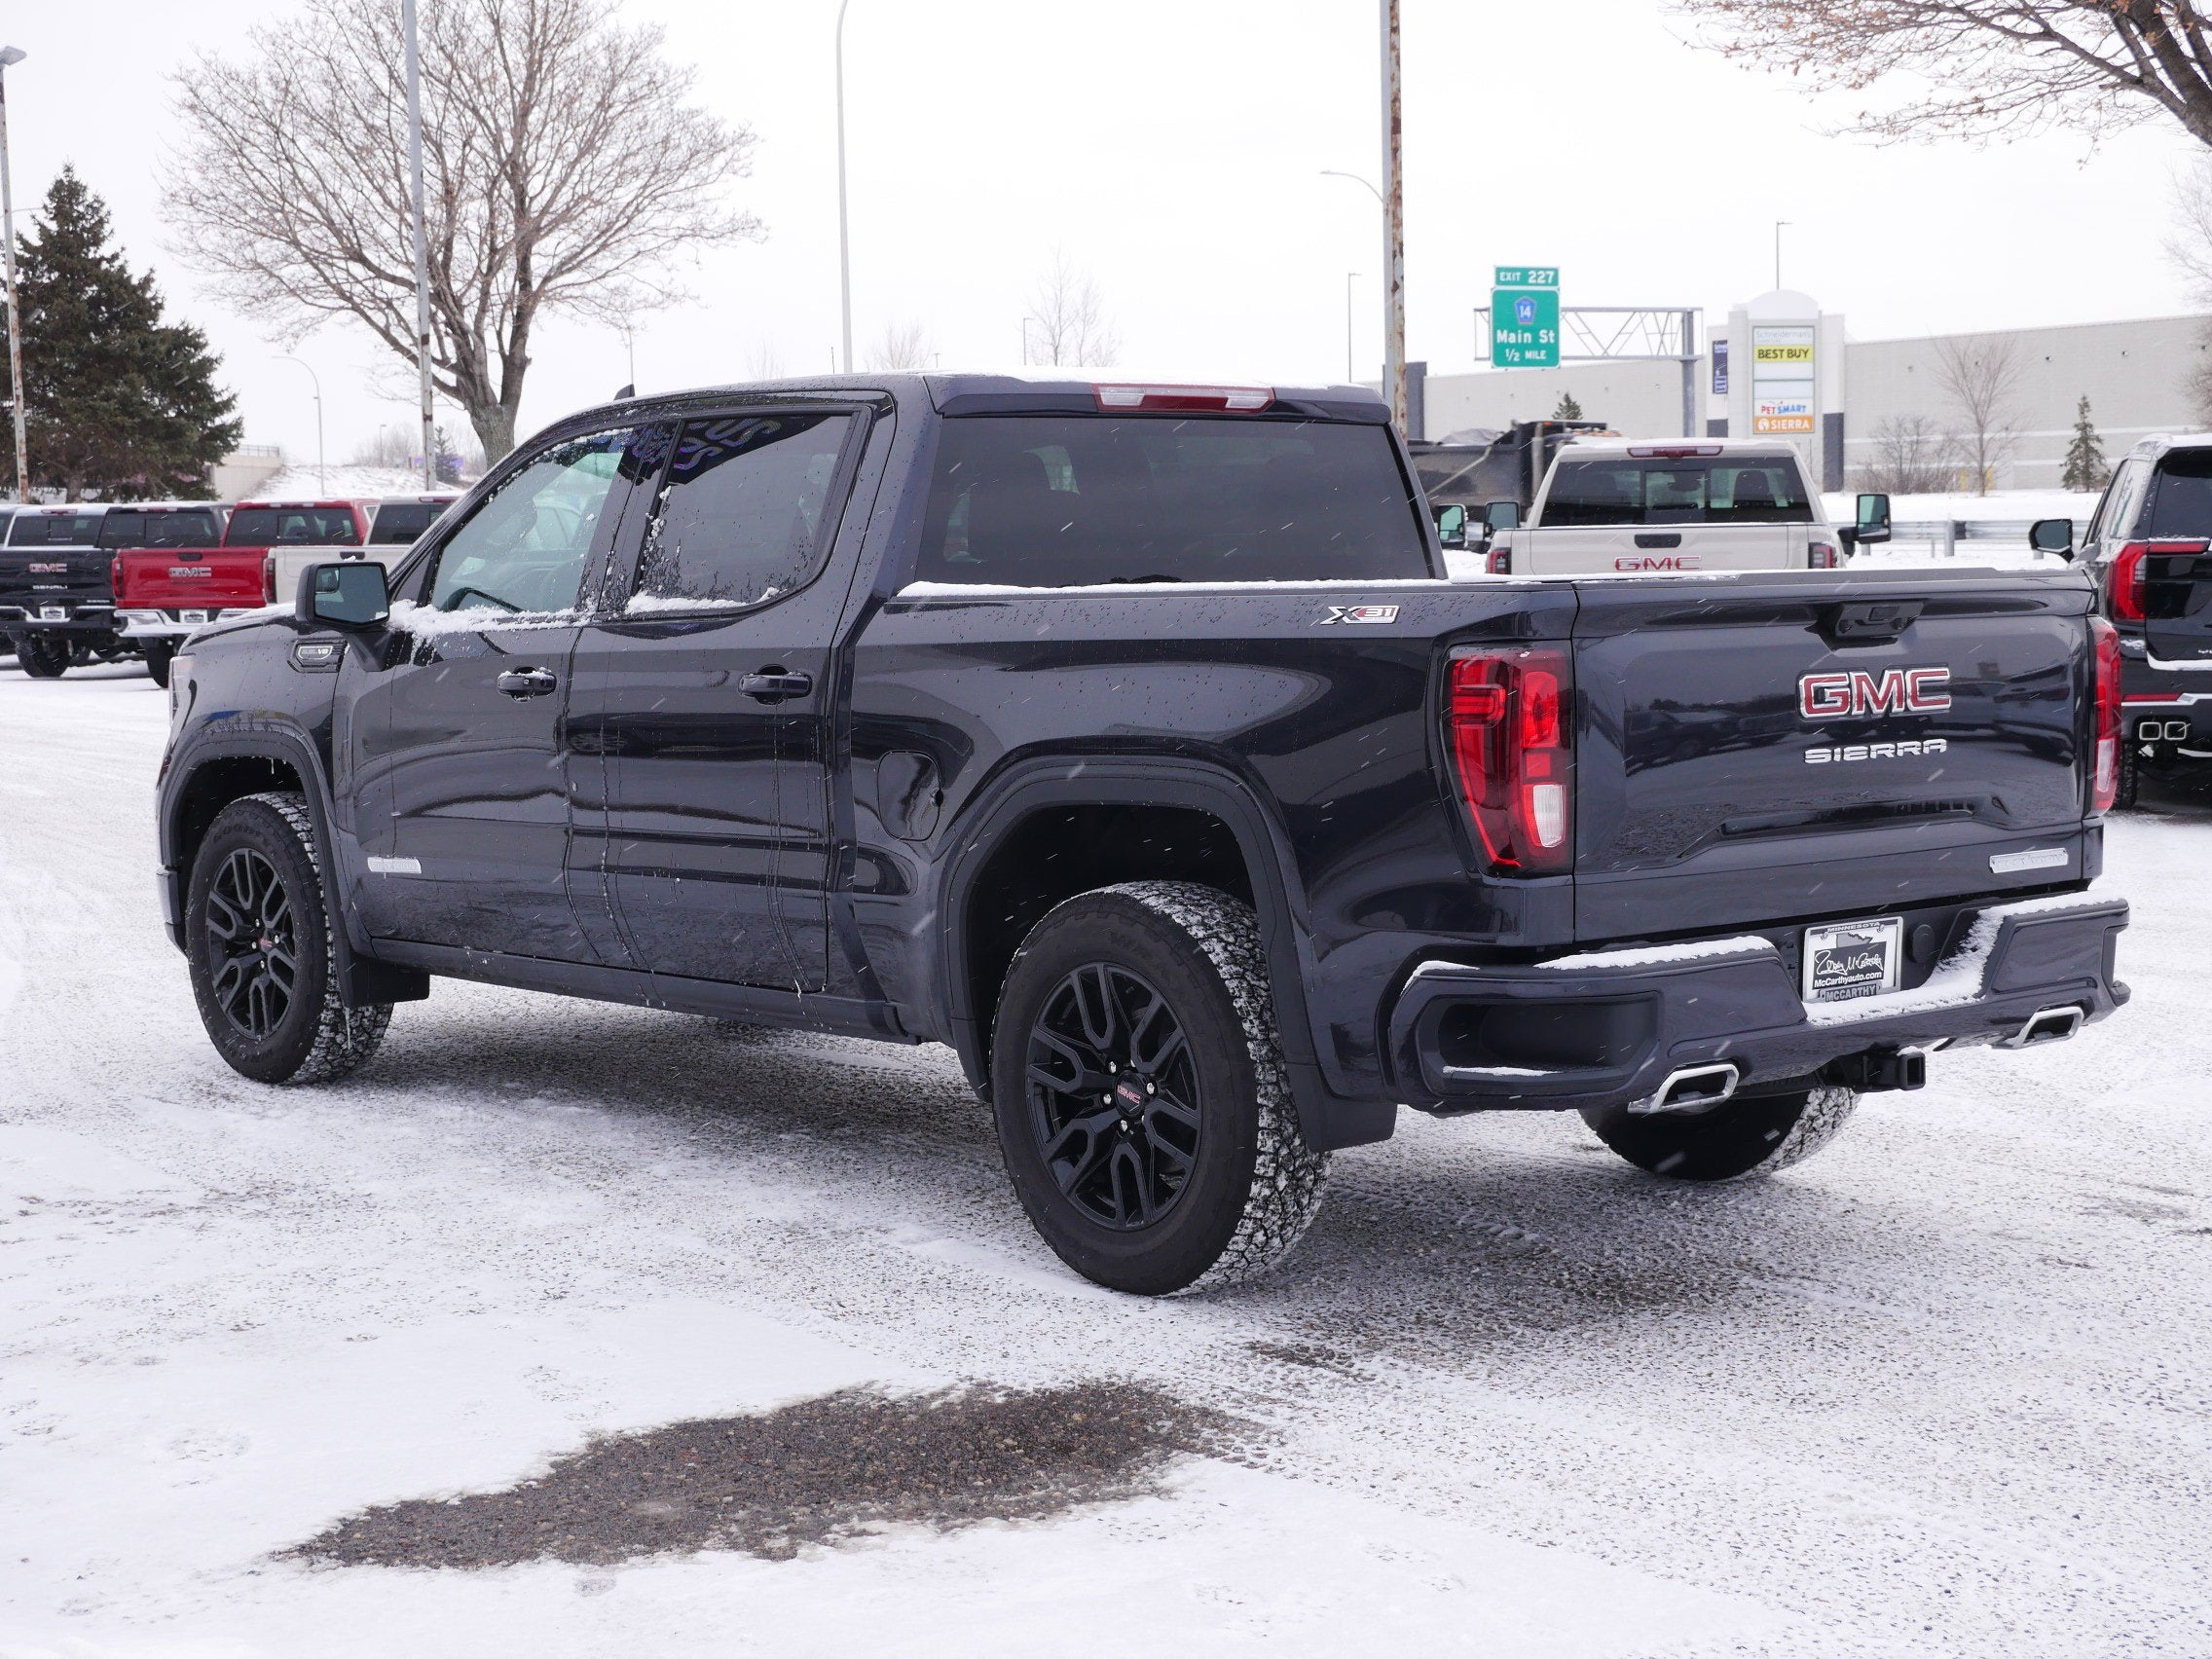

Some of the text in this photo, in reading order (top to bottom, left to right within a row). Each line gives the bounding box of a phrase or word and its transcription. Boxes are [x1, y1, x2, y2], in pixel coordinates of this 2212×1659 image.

[1499, 271, 1555, 283] EXIT 227
[1520, 305, 1531, 318] 14
[1496, 329, 1555, 344] Main St
[1525, 350, 1546, 359] MILE
[1757, 349, 1809, 358] BEST BUY
[1771, 419, 1809, 429] SIERRA
[28, 563, 67, 572] GMC
[1615, 556, 1701, 571] GMC
[168, 567, 211, 577] GMC
[1799, 668, 1951, 718] GMC
[1804, 738, 1947, 764] SIERRA
[1826, 922, 1881, 933] MINNESOTA
[1814, 972, 1882, 988] McCarthyauto.com
[1825, 983, 1876, 1002] MCCARTHY
